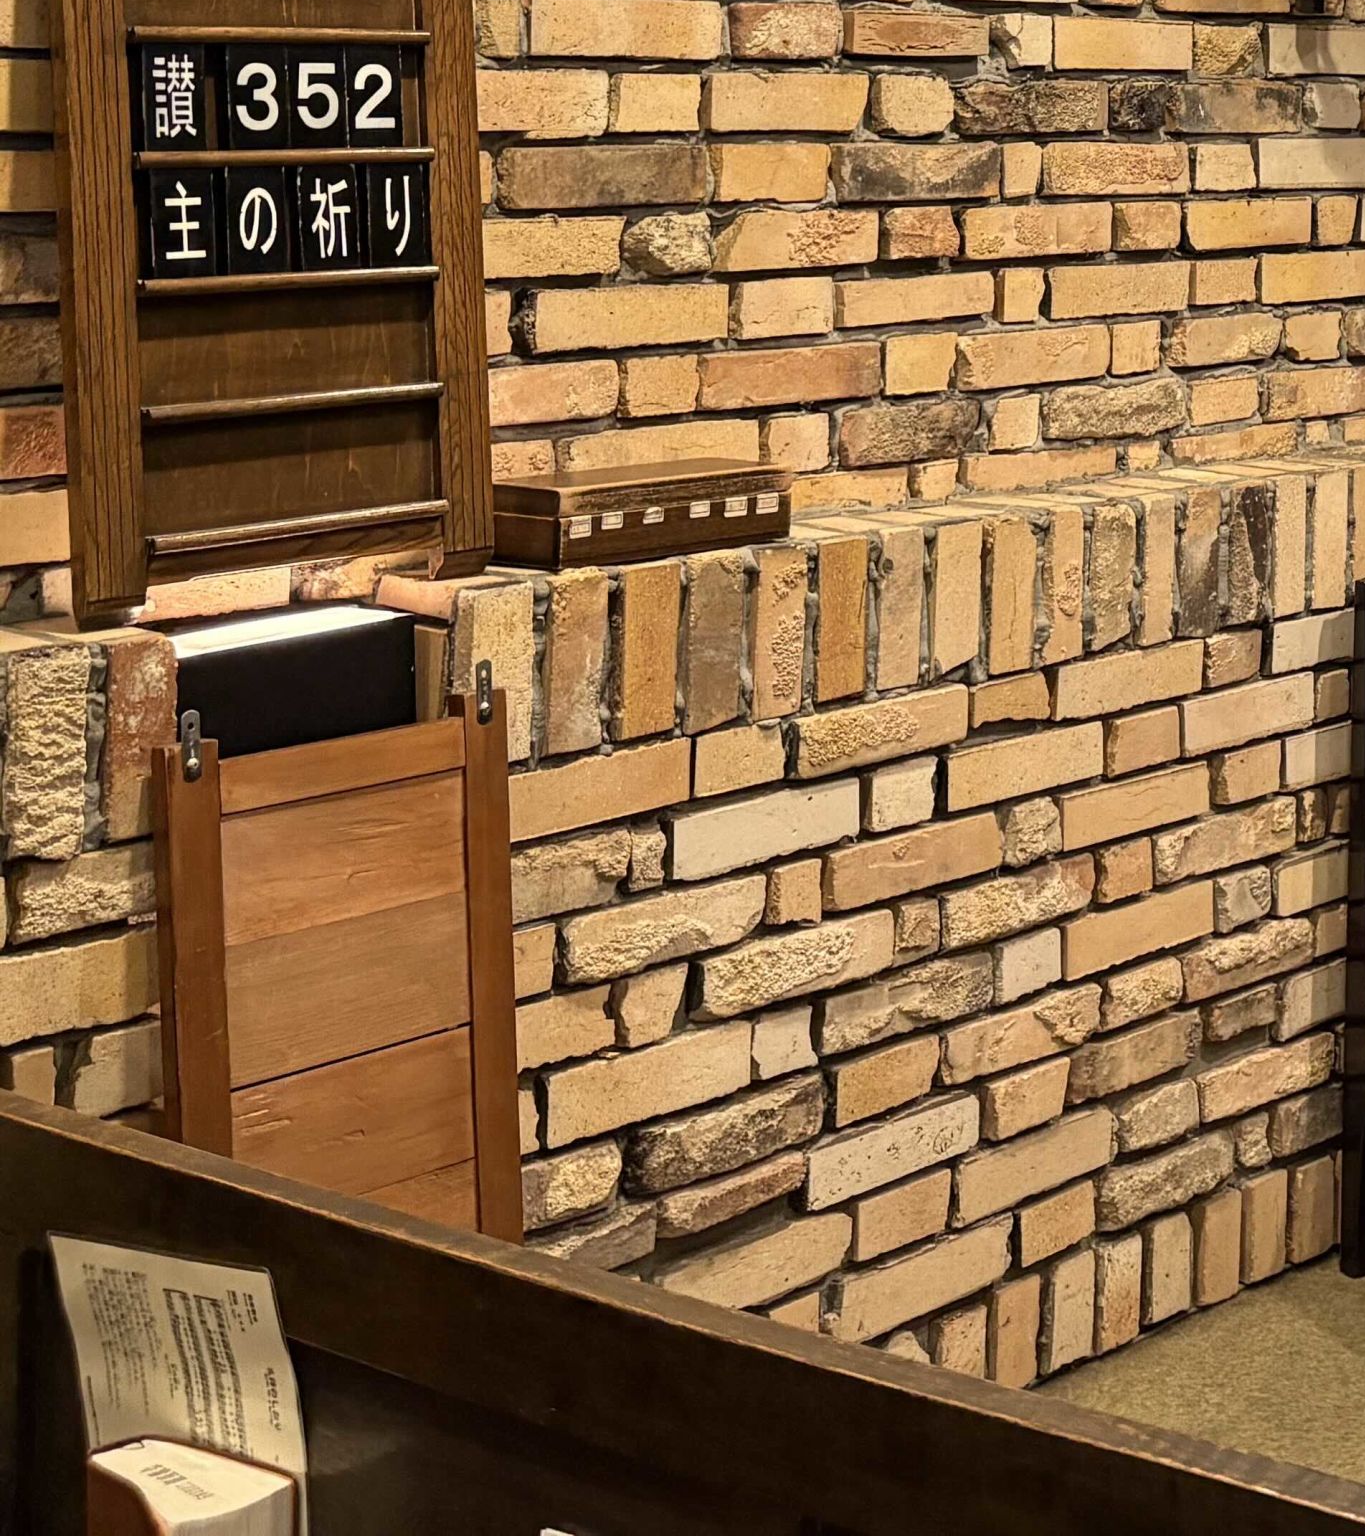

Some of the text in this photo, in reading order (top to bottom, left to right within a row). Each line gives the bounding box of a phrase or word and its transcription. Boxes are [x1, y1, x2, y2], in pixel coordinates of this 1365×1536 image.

[152, 54, 396, 138] 讃 352
[164, 175, 411, 260] 主の祈り
